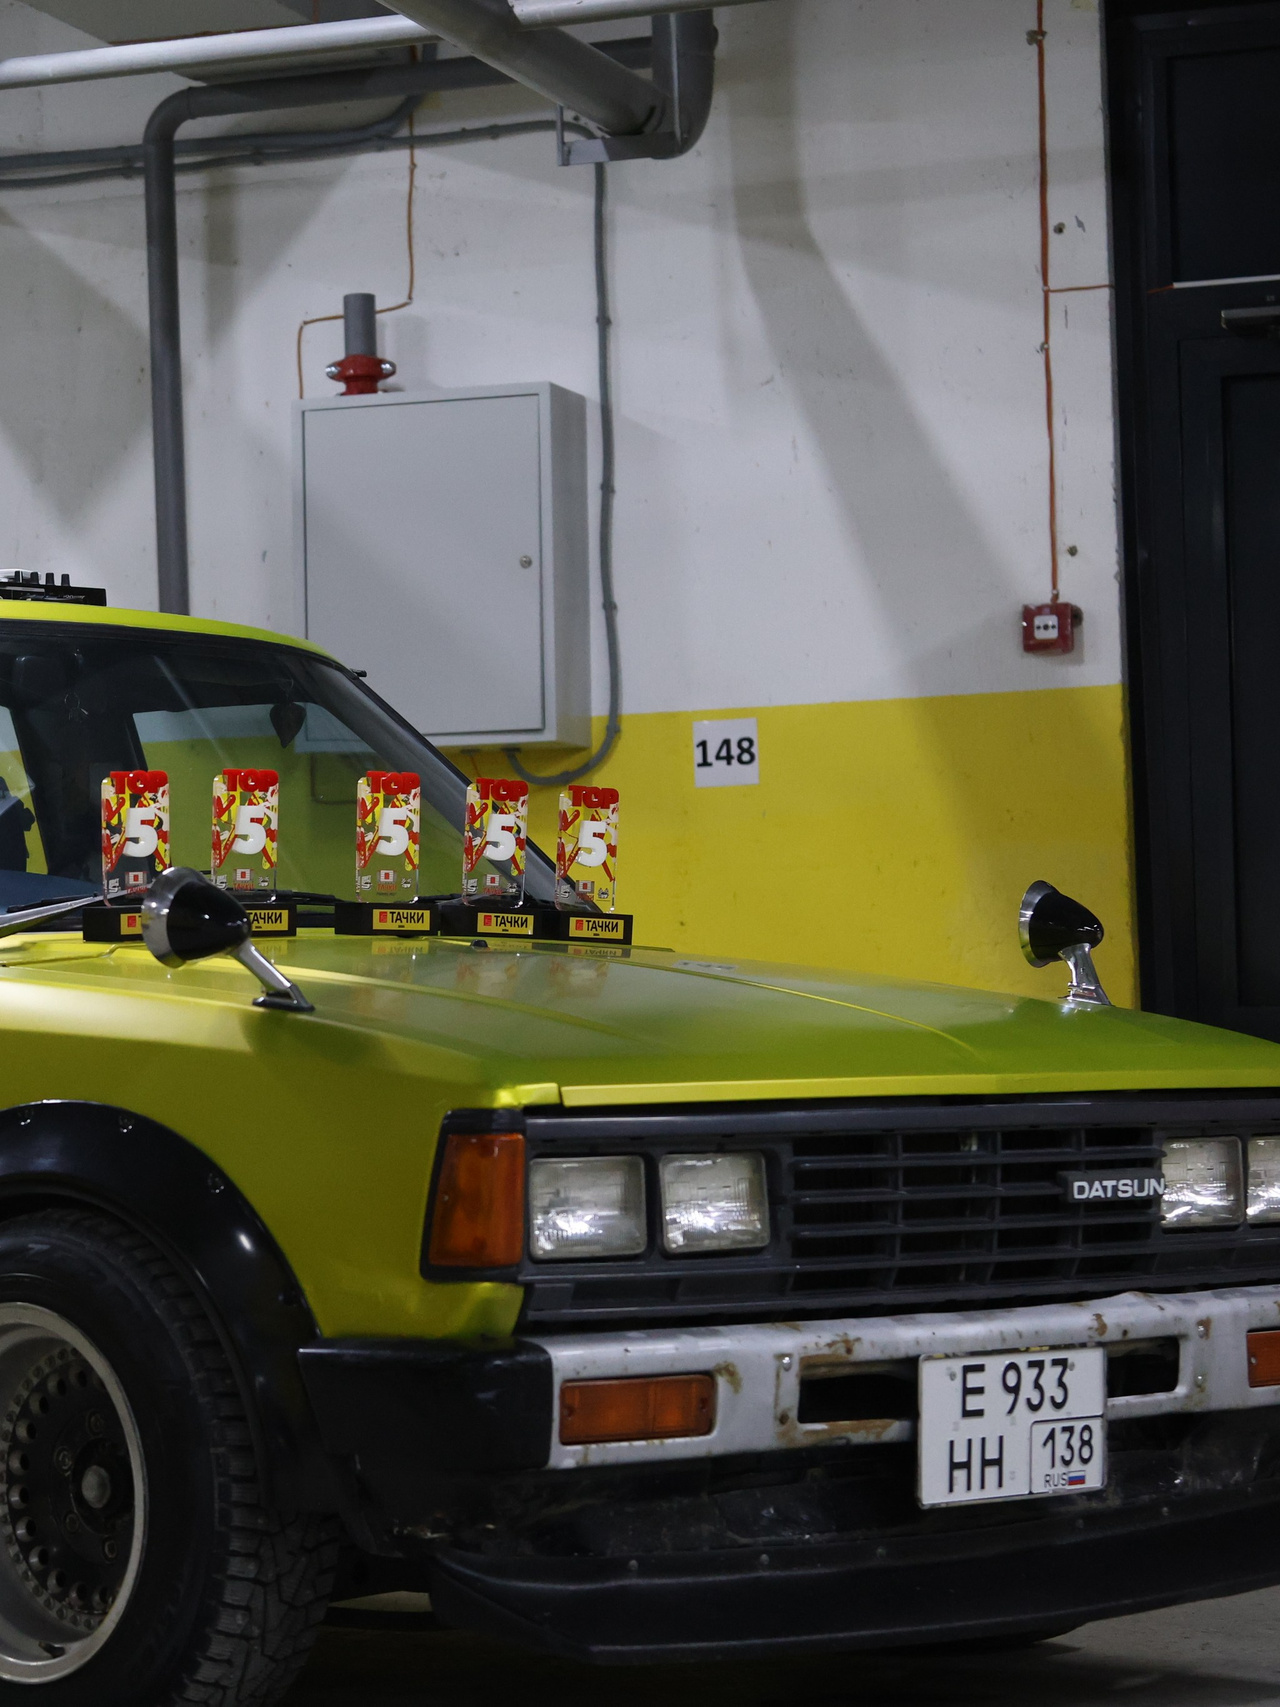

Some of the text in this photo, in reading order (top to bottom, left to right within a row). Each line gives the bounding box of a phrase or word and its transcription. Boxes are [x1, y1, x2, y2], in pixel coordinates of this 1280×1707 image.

[696, 736, 755, 767] 148
[123, 807, 158, 857] 5
[231, 805, 267, 855] 5
[375, 807, 409, 856] 5
[483, 813, 516, 861] 5
[575, 820, 607, 867] 5
[389, 911, 424, 924] ТАЧКИ
[494, 915, 528, 928] ТАЧКИ
[585, 920, 619, 933] ТАЧКИ
[1073, 1178, 1164, 1199] DATSUN
[1001, 1357, 1069, 1415] 933
[1042, 1424, 1094, 1469] 138
[1044, 1472, 1068, 1488] RUS
